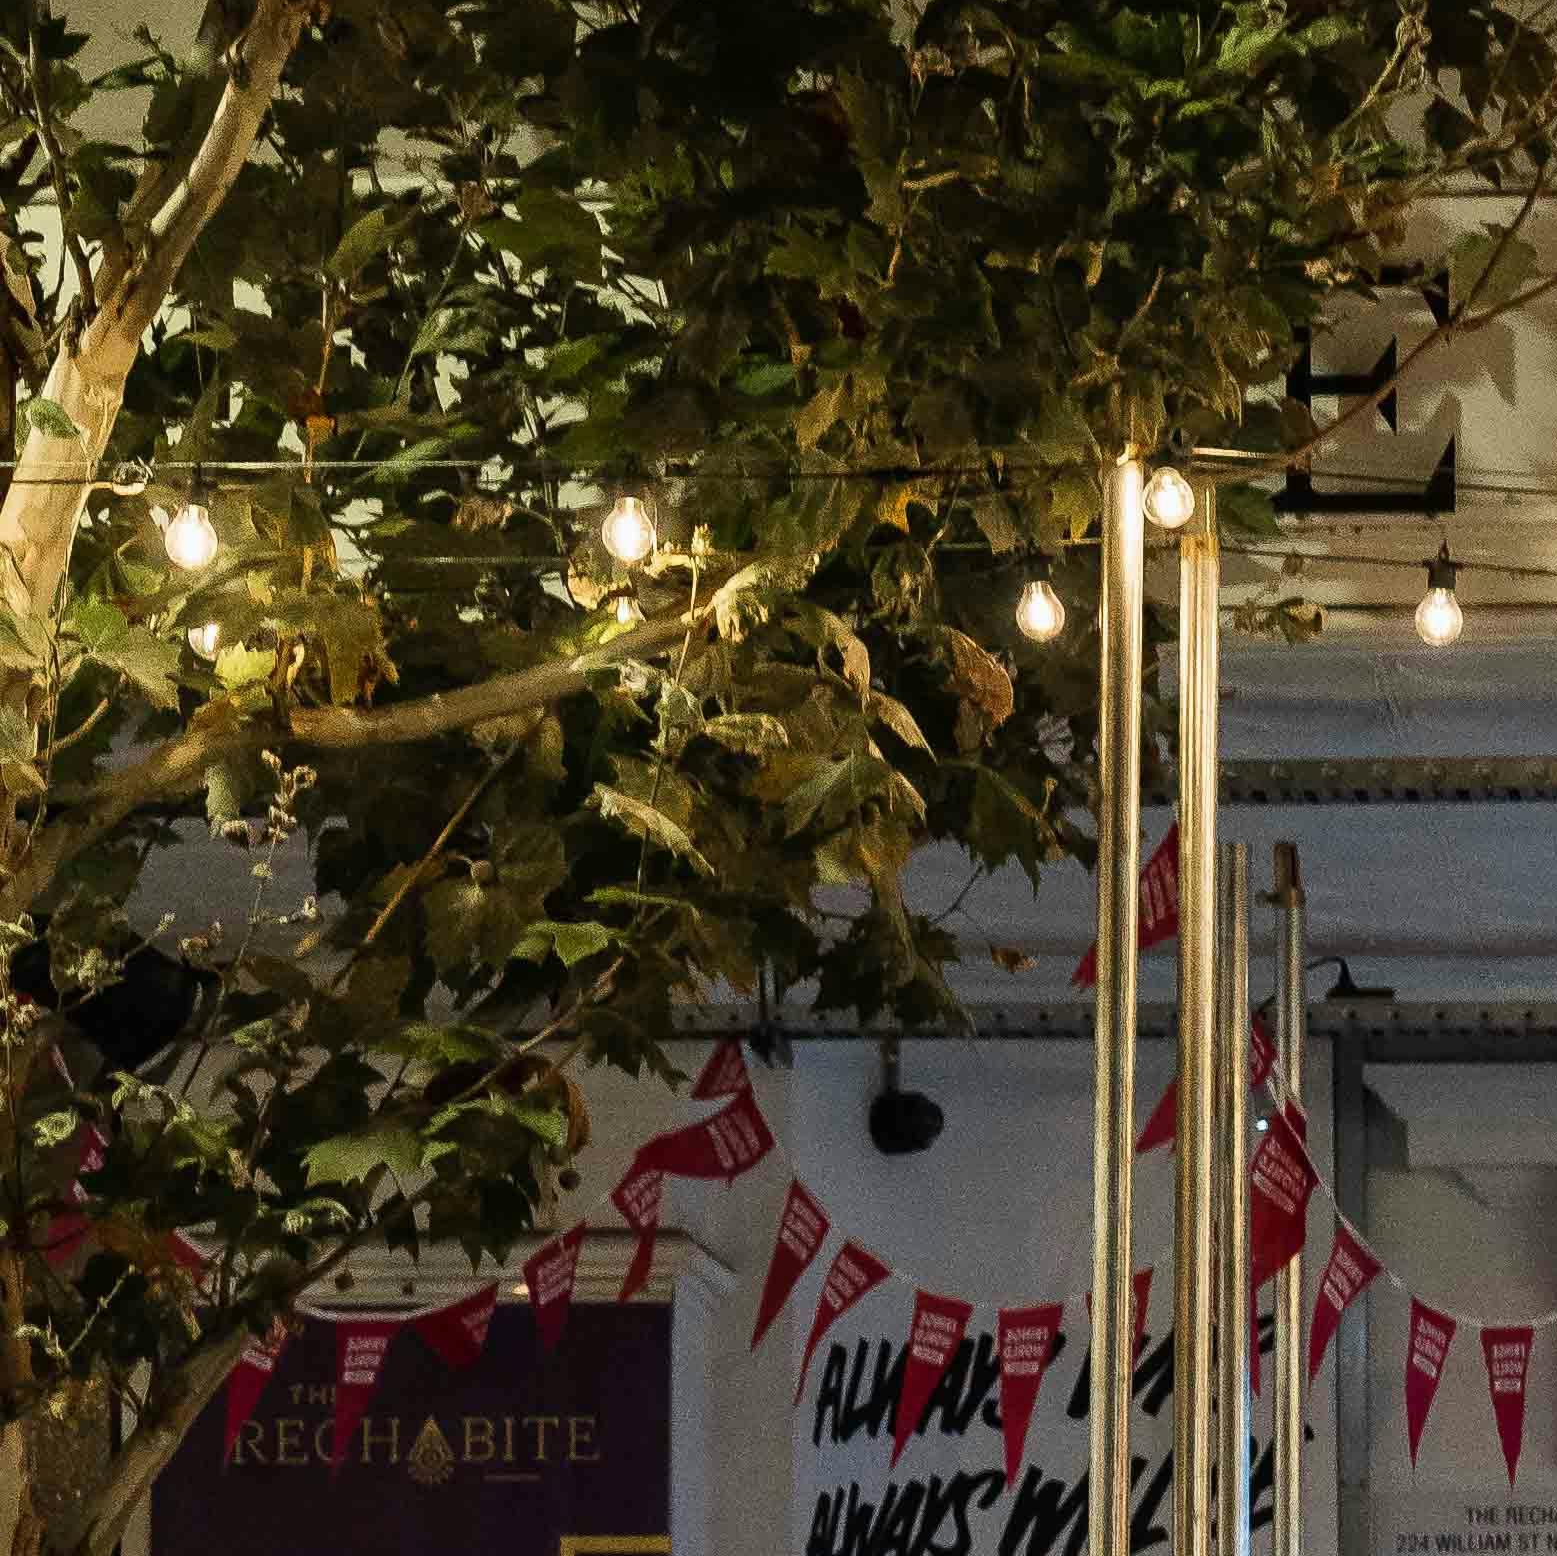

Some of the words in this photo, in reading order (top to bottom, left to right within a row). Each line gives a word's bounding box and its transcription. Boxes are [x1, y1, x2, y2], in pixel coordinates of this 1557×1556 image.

[812, 1328, 1066, 1447] ALWAY
[232, 1414, 601, 1467] RECHABITE
[1465, 1505, 1499, 1525] THE
[1435, 1532, 1511, 1553] WILLIAM
[1518, 1532, 1539, 1552] ST
